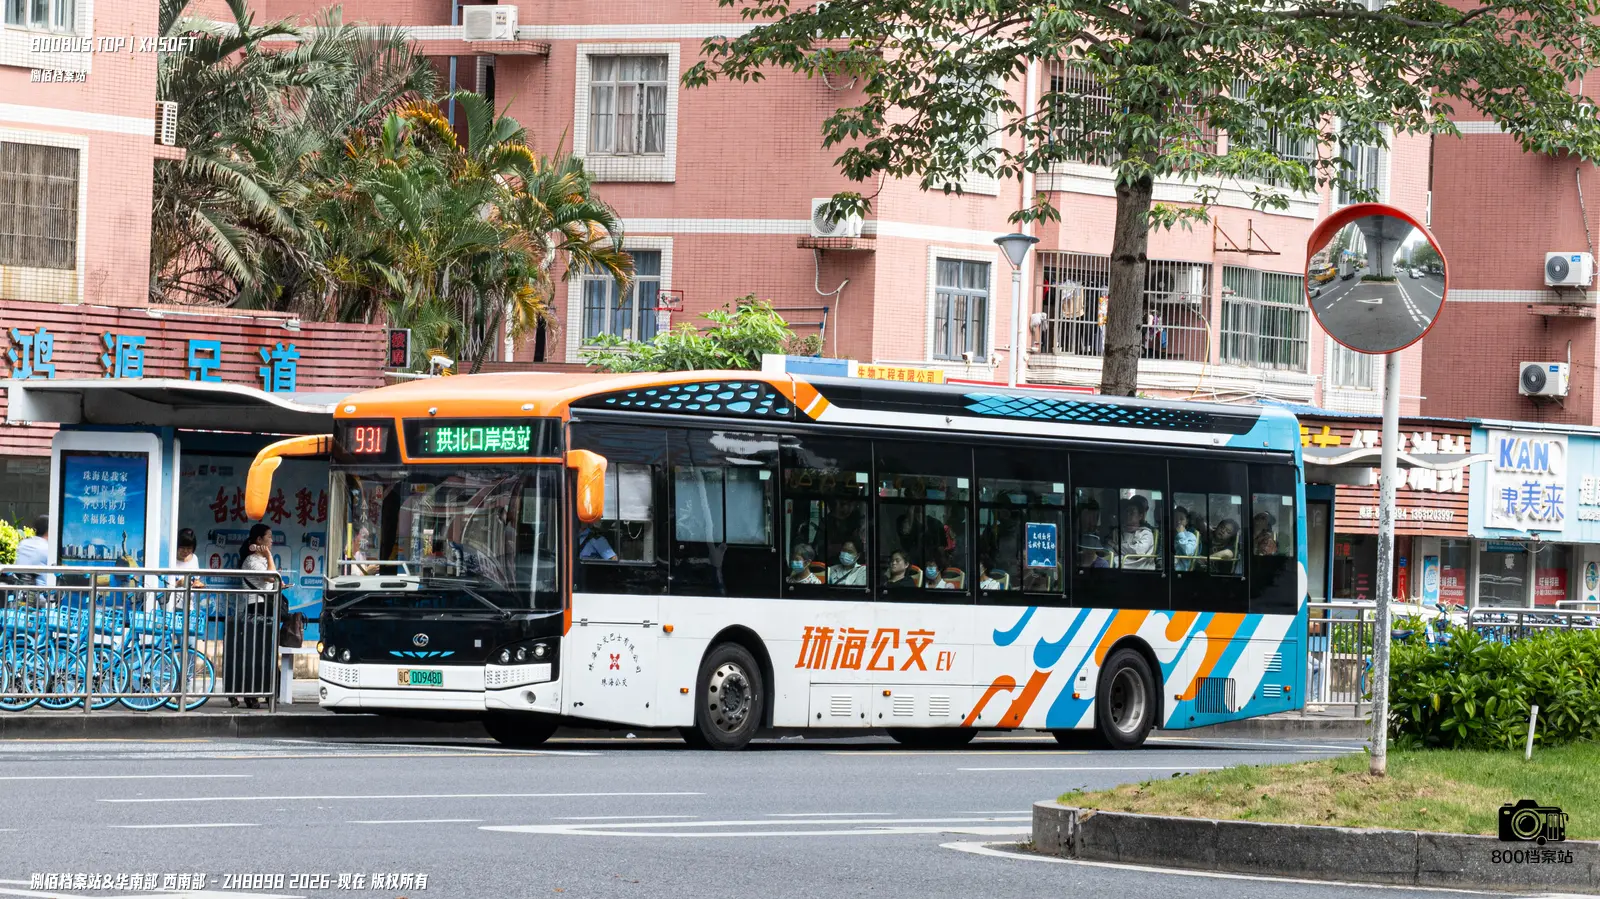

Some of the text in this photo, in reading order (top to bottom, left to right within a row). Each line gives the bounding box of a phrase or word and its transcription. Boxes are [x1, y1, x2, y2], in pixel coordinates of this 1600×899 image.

[7, 326, 301, 393] 鸿源足道
[858, 367, 935, 383] 生物工程有限公司
[355, 427, 381, 453] 931
[436, 426, 531, 453] 拱北口岸总站
[83, 471, 128, 482] 珠海是我家
[82, 513, 125, 525] 幸福你我他
[209, 486, 329, 527] 舌尖味聚
[794, 626, 956, 672] 珠海公交 EV
[601, 677, 628, 688] 珠海公交
